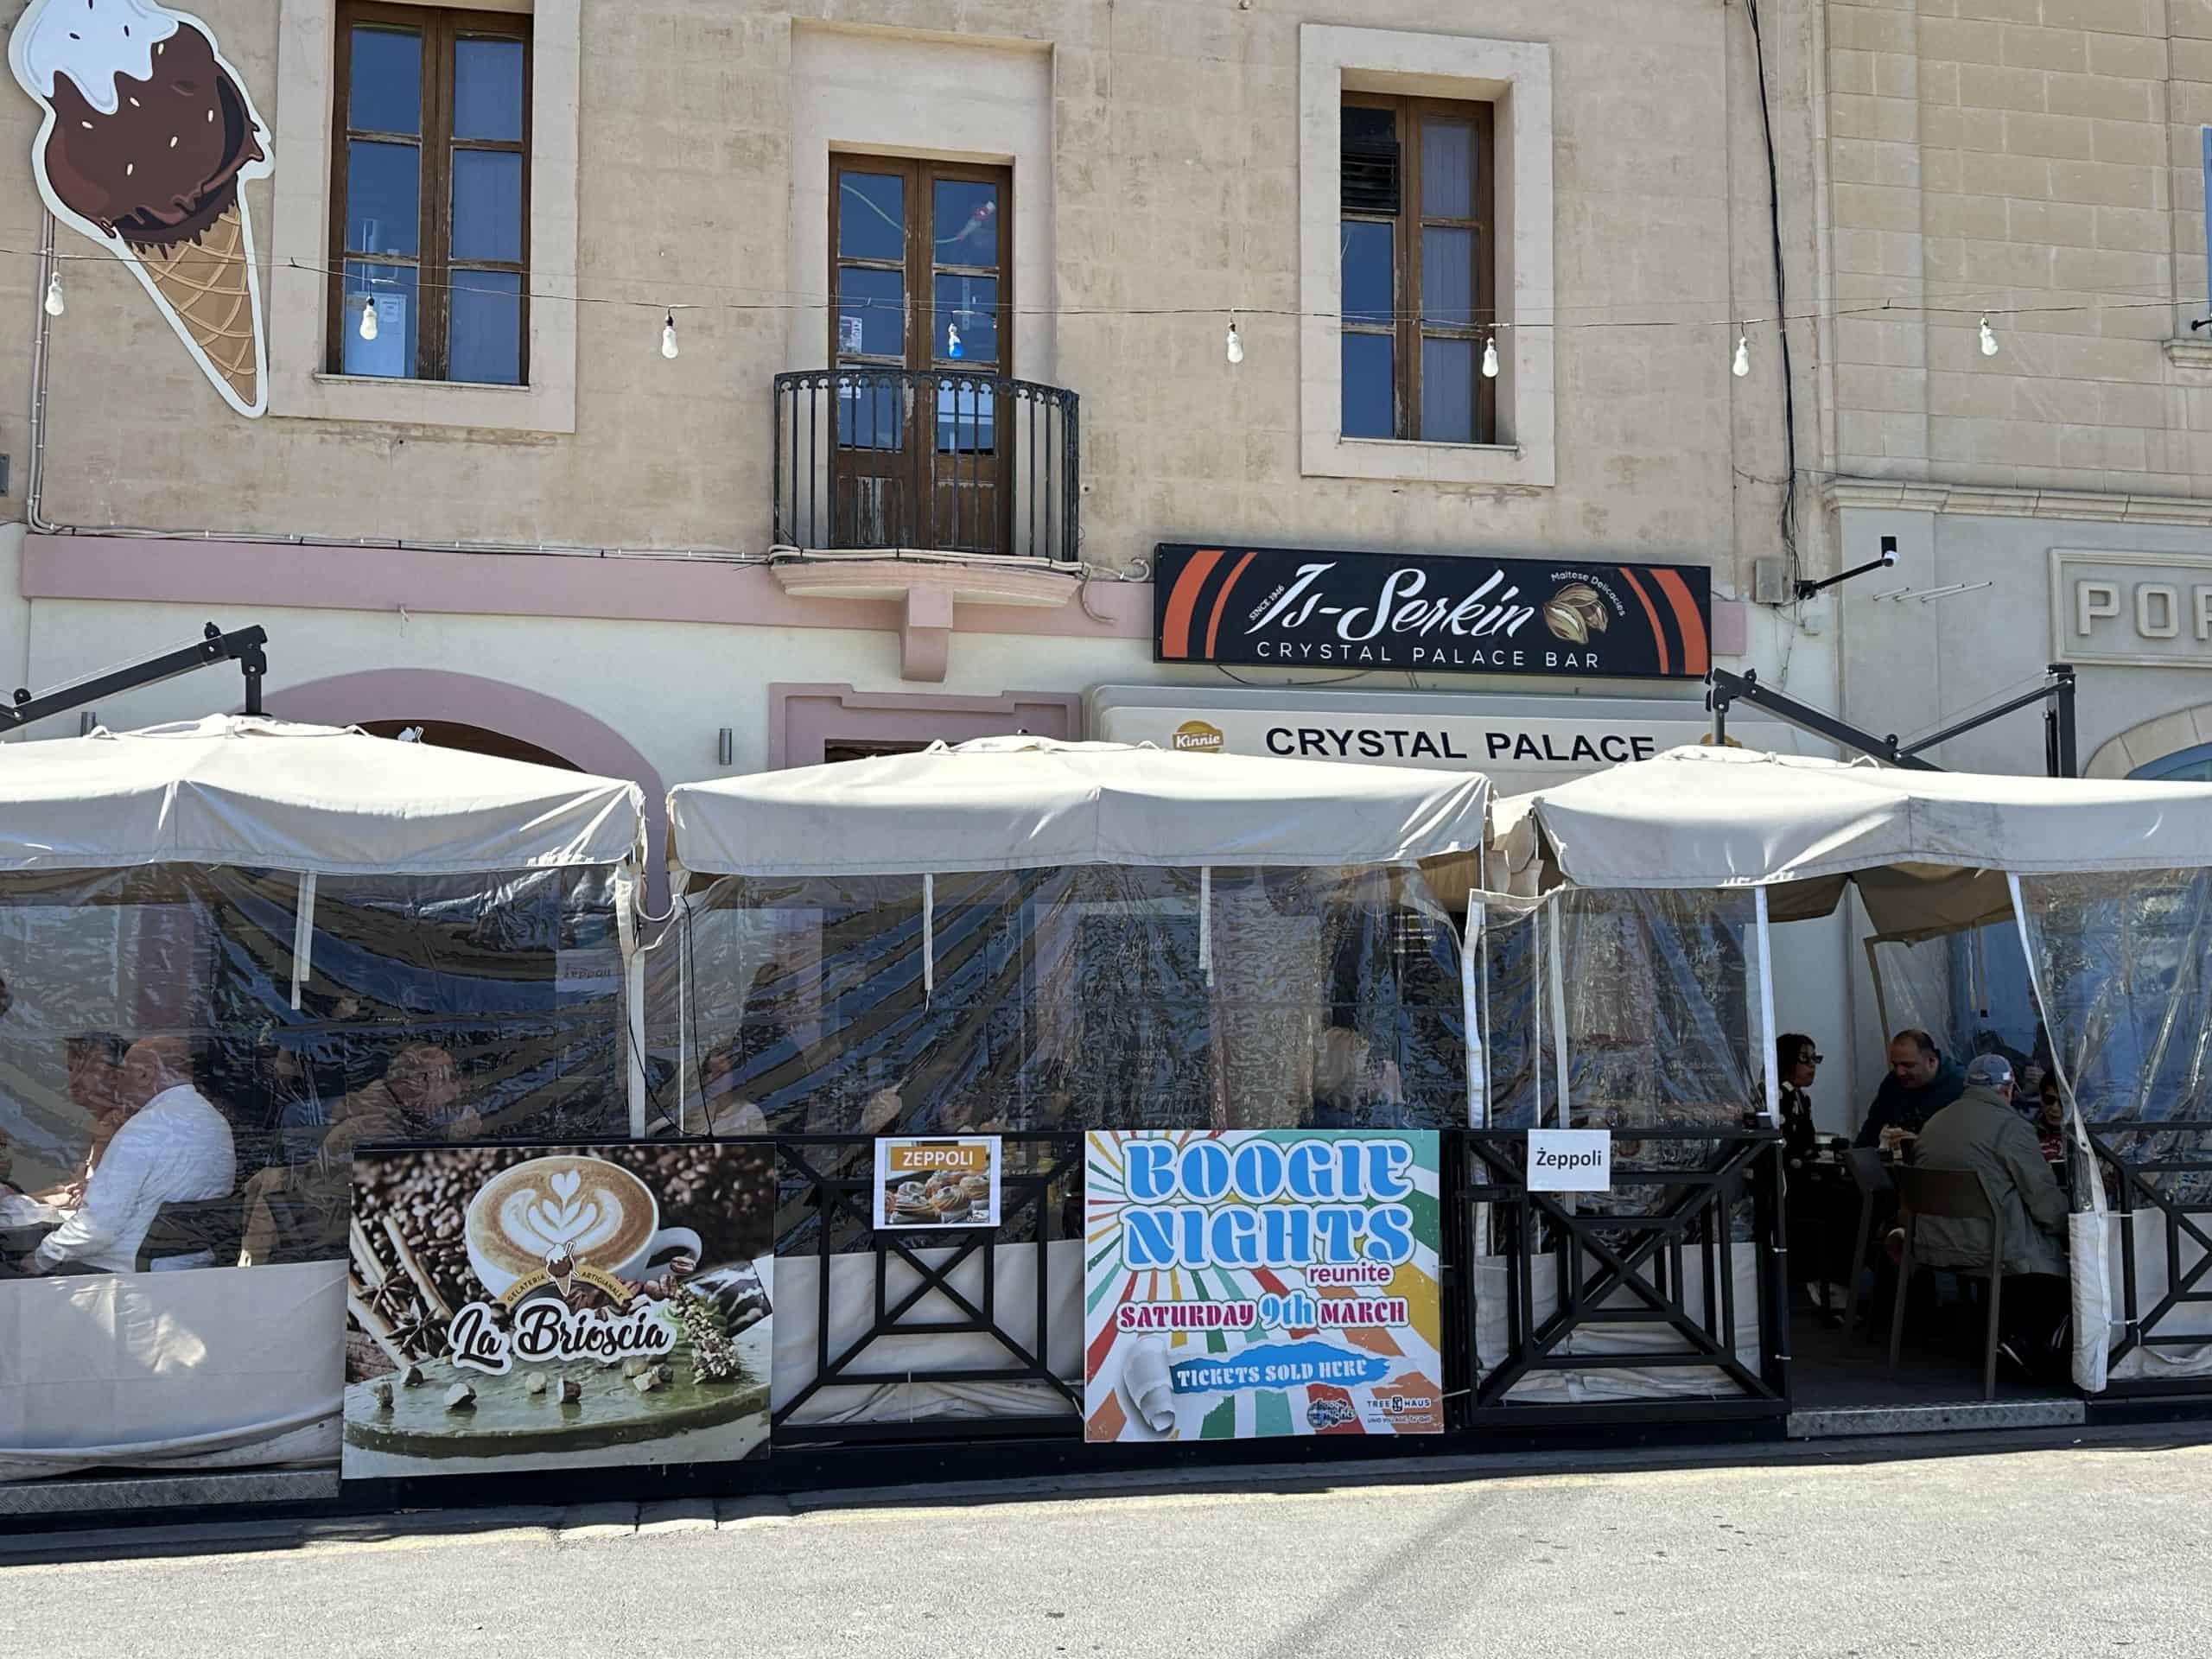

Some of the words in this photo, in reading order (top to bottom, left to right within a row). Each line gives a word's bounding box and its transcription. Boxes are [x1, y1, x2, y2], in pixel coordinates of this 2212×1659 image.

[1243, 562, 1535, 641] Is-Serkin
[1551, 571, 1589, 582] Maltese
[1591, 575, 1625, 616] Delicacies
[1249, 598, 1271, 621] SINCE
[1256, 641, 1392, 662] CRYSTAL
[1413, 647, 1525, 666] PALACE
[1545, 652, 1599, 669] BAR
[1176, 734, 1221, 748] Kinnie
[1265, 728, 1467, 760] CRYSTAL
[1485, 732, 1655, 763] PALACE
[903, 1150, 973, 1167] ZEPPOLI
[1126, 1145, 1411, 1199] BOOGIE
[1536, 1147, 1602, 1170] Żeppoli
[1123, 1209, 1412, 1266] NIGHTS
[507, 1274, 546, 1302] GELATERIA
[581, 1271, 624, 1299] ARTIGIANALE
[1309, 1263, 1391, 1284] reunite
[1121, 1305, 1255, 1329] SATURDAY
[1262, 1294, 1314, 1325] 9th
[1319, 1301, 1405, 1325] MARCH
[454, 1308, 505, 1368] La
[518, 1304, 670, 1356] Brioscia
[1177, 1366, 1260, 1388] TICKETS
[1264, 1363, 1314, 1383] SOLD
[1318, 1359, 1369, 1378] HERE
[1367, 1400, 1390, 1408] TREE
